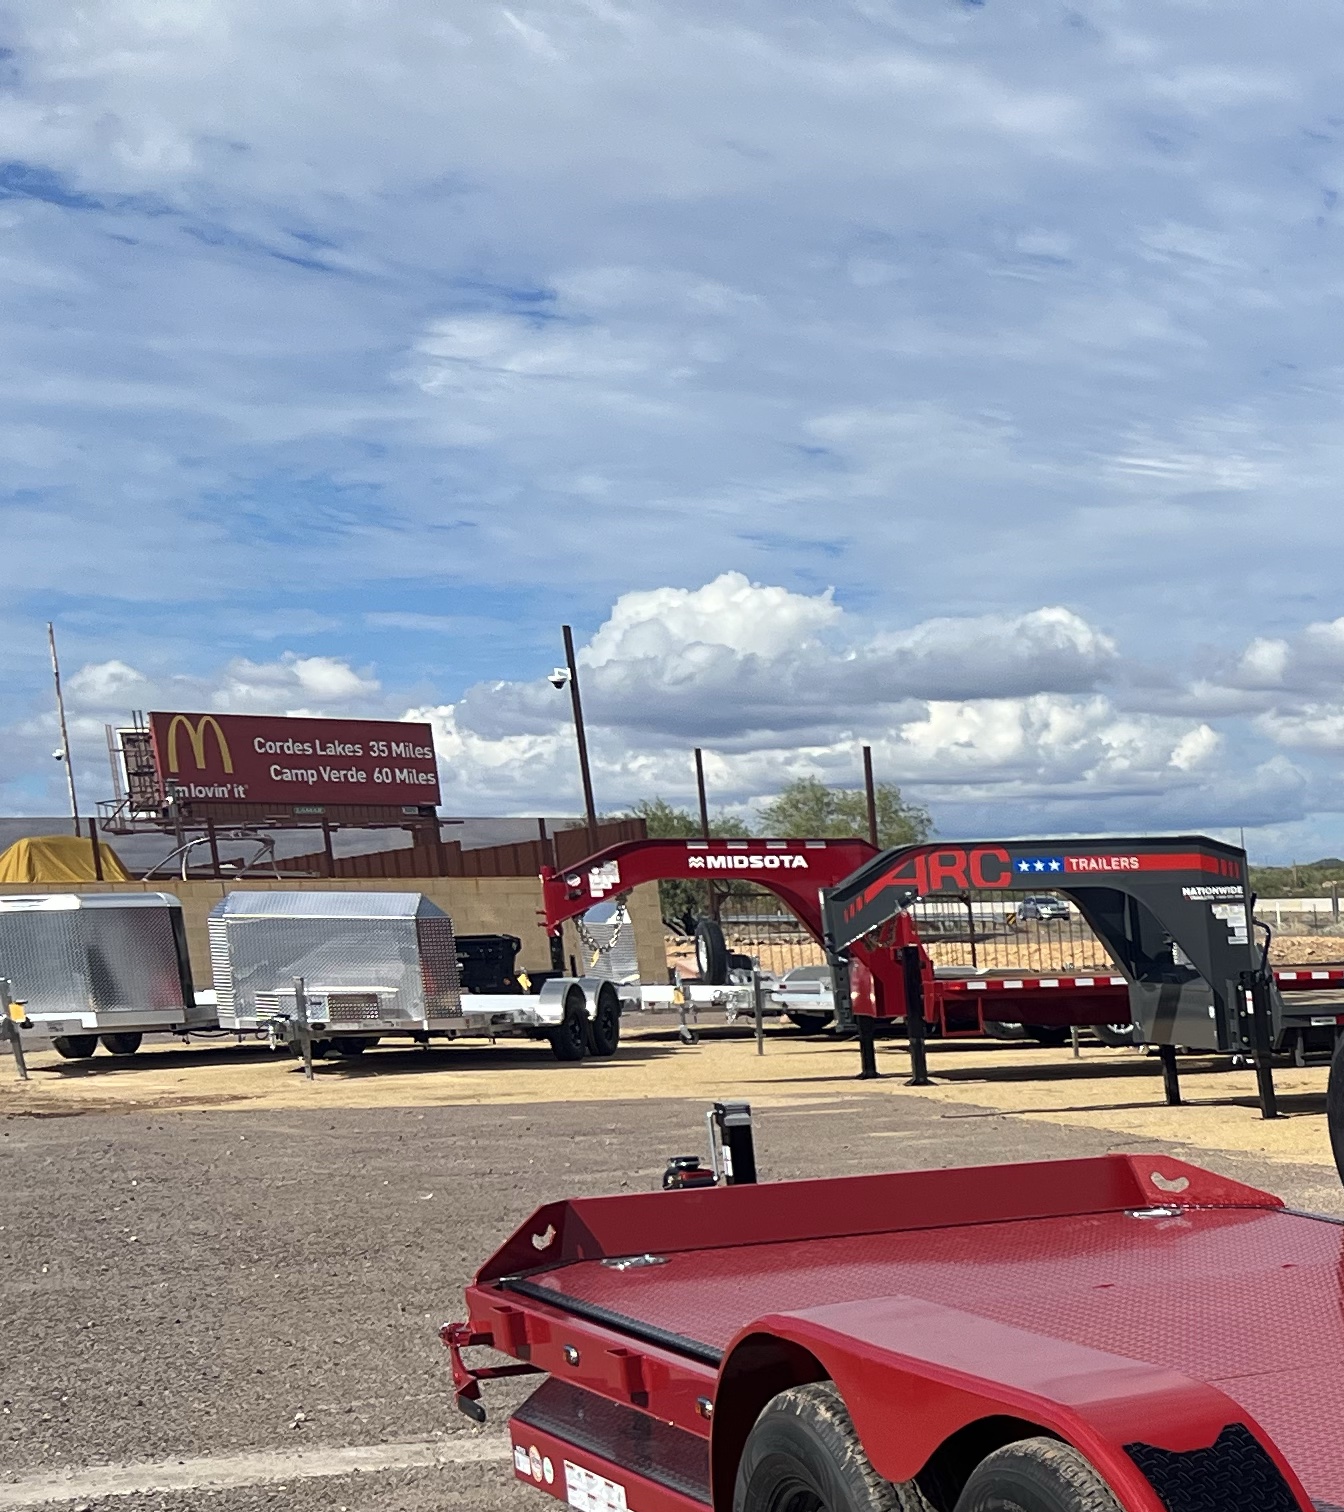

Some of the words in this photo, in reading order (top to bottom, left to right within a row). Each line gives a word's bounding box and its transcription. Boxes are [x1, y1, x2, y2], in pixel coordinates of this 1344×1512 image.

[254, 737, 313, 755] Cordes
[315, 739, 363, 756] Lakes
[369, 741, 388, 757] 35
[391, 741, 433, 759] Miles
[270, 765, 317, 785] Camp
[320, 766, 367, 782] Verde
[373, 768, 391, 783] 60
[396, 768, 436, 785] Miles
[190, 783, 231, 798] lovin'
[706, 855, 808, 869] MIDSOTA
[1069, 856, 1139, 872] TRAILERS
[864, 843, 1012, 902] ARC
[1182, 885, 1243, 896] NATIONWIDE
